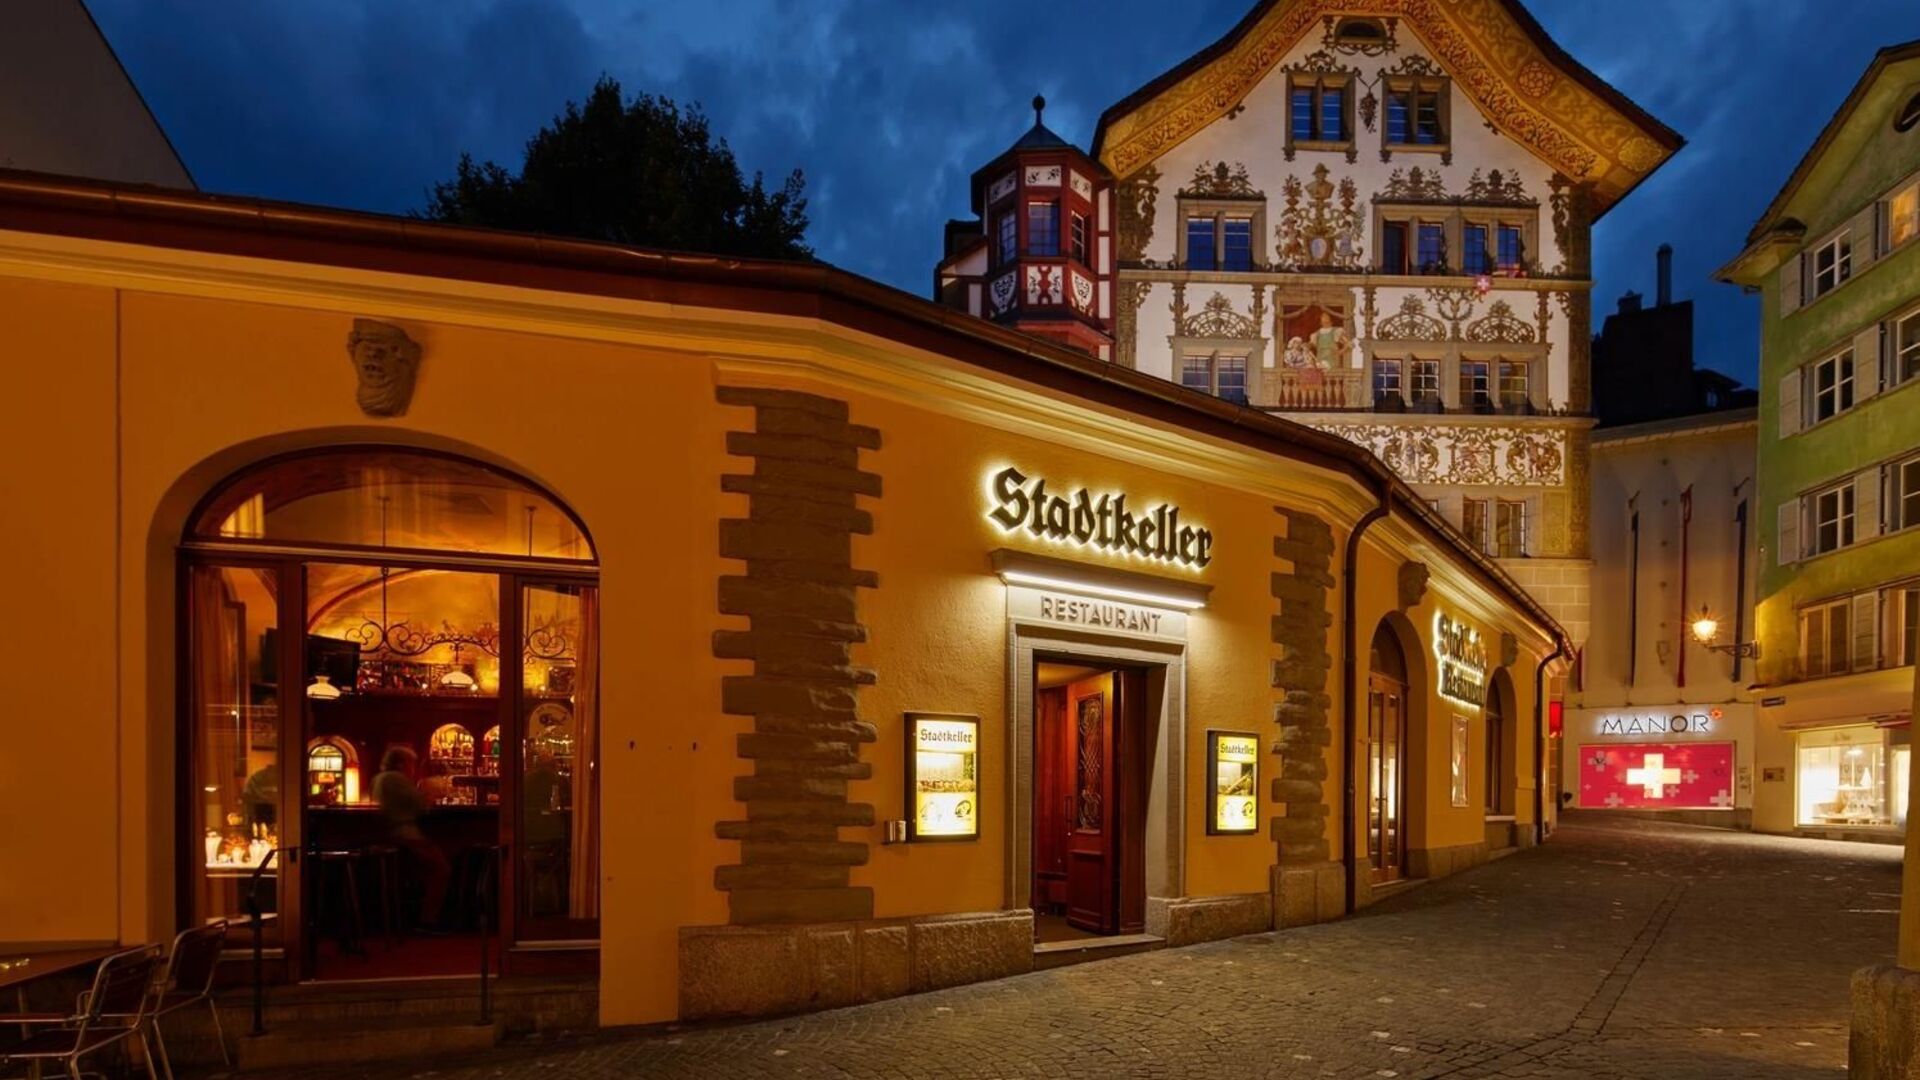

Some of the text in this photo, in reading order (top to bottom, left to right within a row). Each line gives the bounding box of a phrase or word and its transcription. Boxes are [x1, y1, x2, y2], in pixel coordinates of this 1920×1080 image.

[989, 467, 1213, 568] Stadtkeller
[1040, 595, 1161, 634] RESTAURANT
[920, 728, 973, 743] Stadtkeller
[1602, 714, 1709, 735] MANOR
